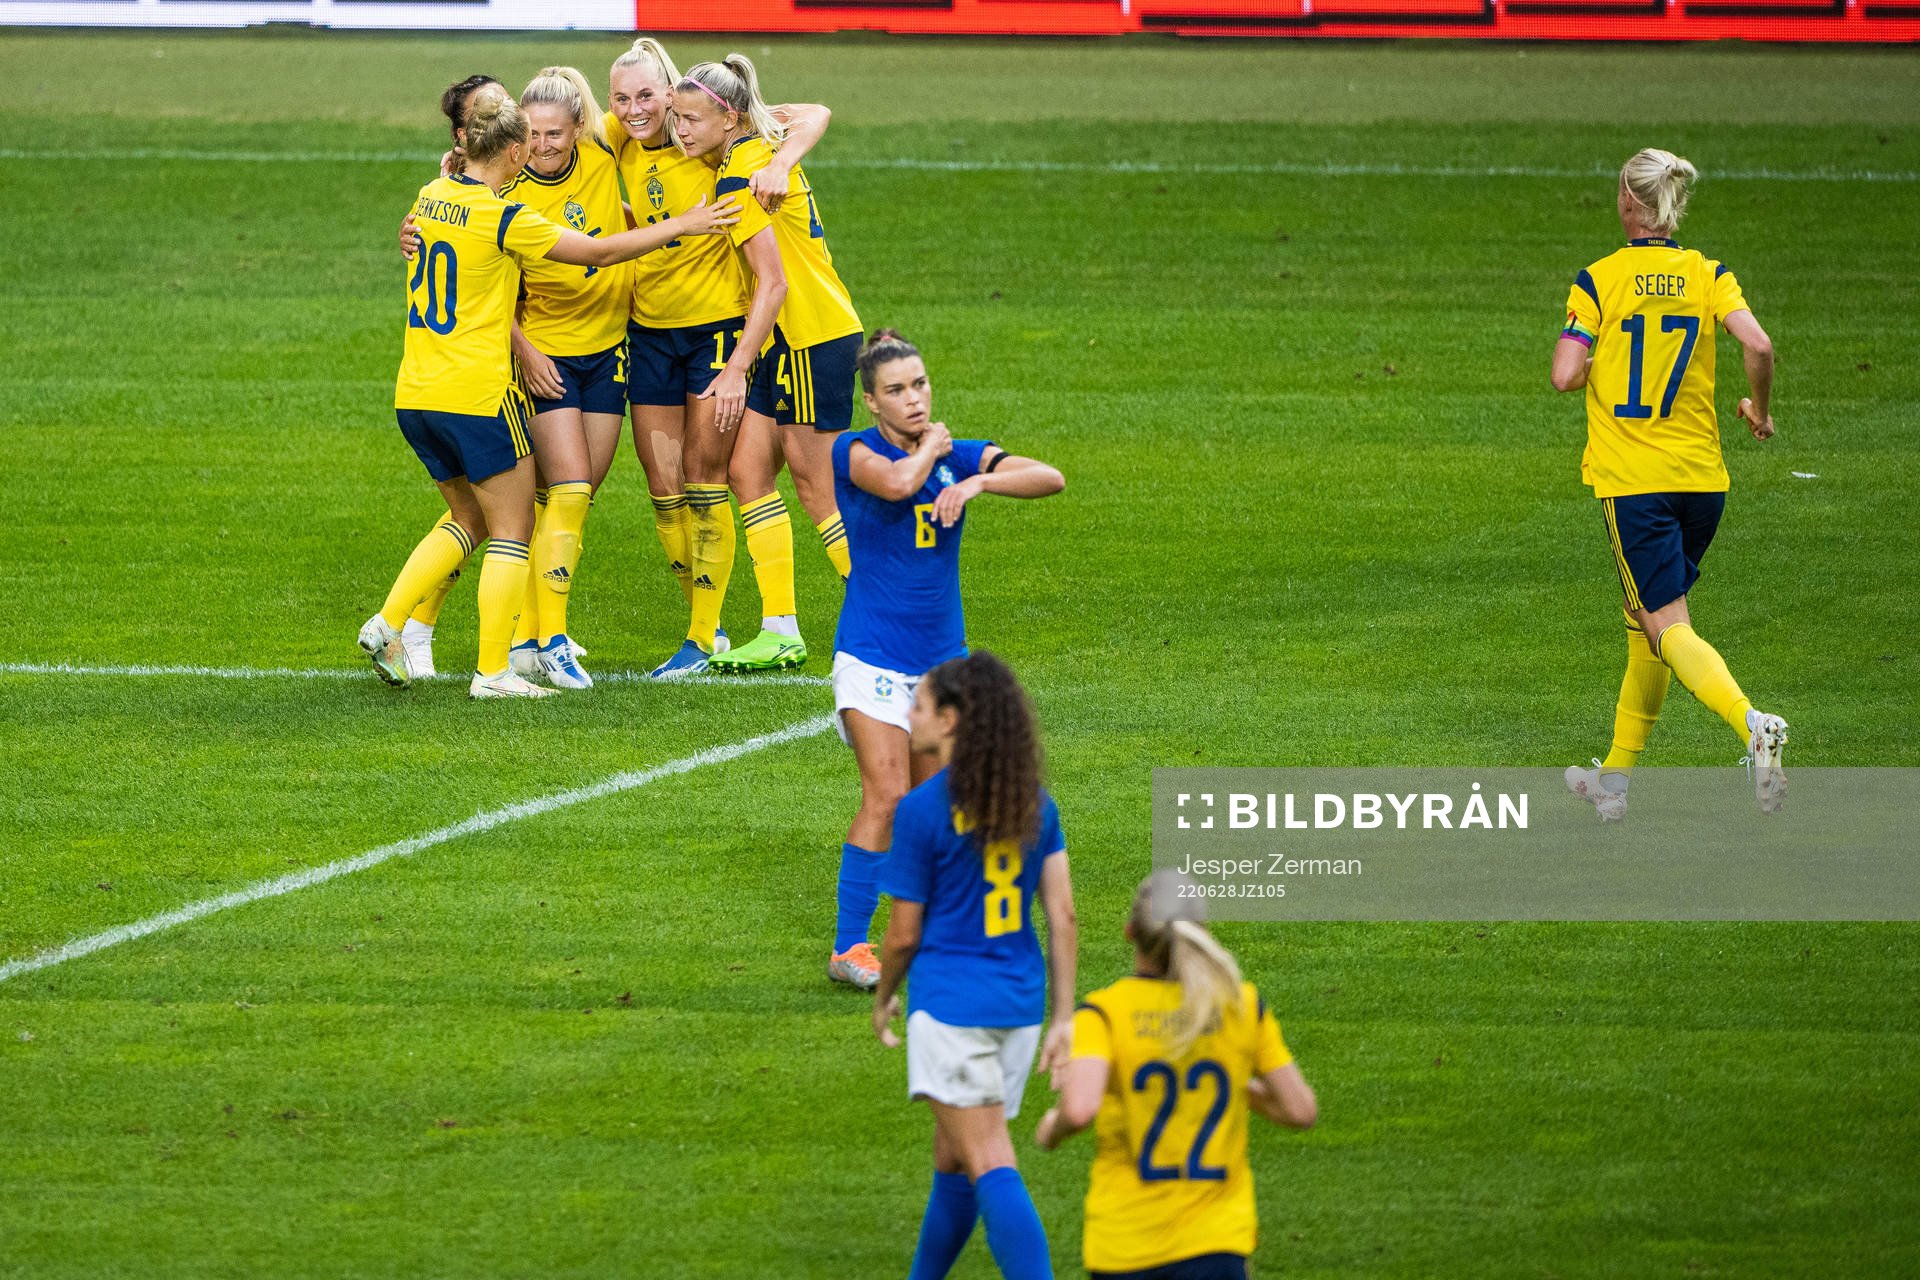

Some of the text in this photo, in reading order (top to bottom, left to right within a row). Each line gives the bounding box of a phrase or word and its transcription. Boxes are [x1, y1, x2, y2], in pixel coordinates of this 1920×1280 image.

[409, 233, 458, 335] 20
[1634, 273, 1686, 297] SEGER
[776, 353, 792, 395] 4
[1613, 313, 1700, 419] 17
[913, 503, 937, 549] 6
[983, 839, 1022, 938] 8
[1132, 1059, 1231, 1182] 22
